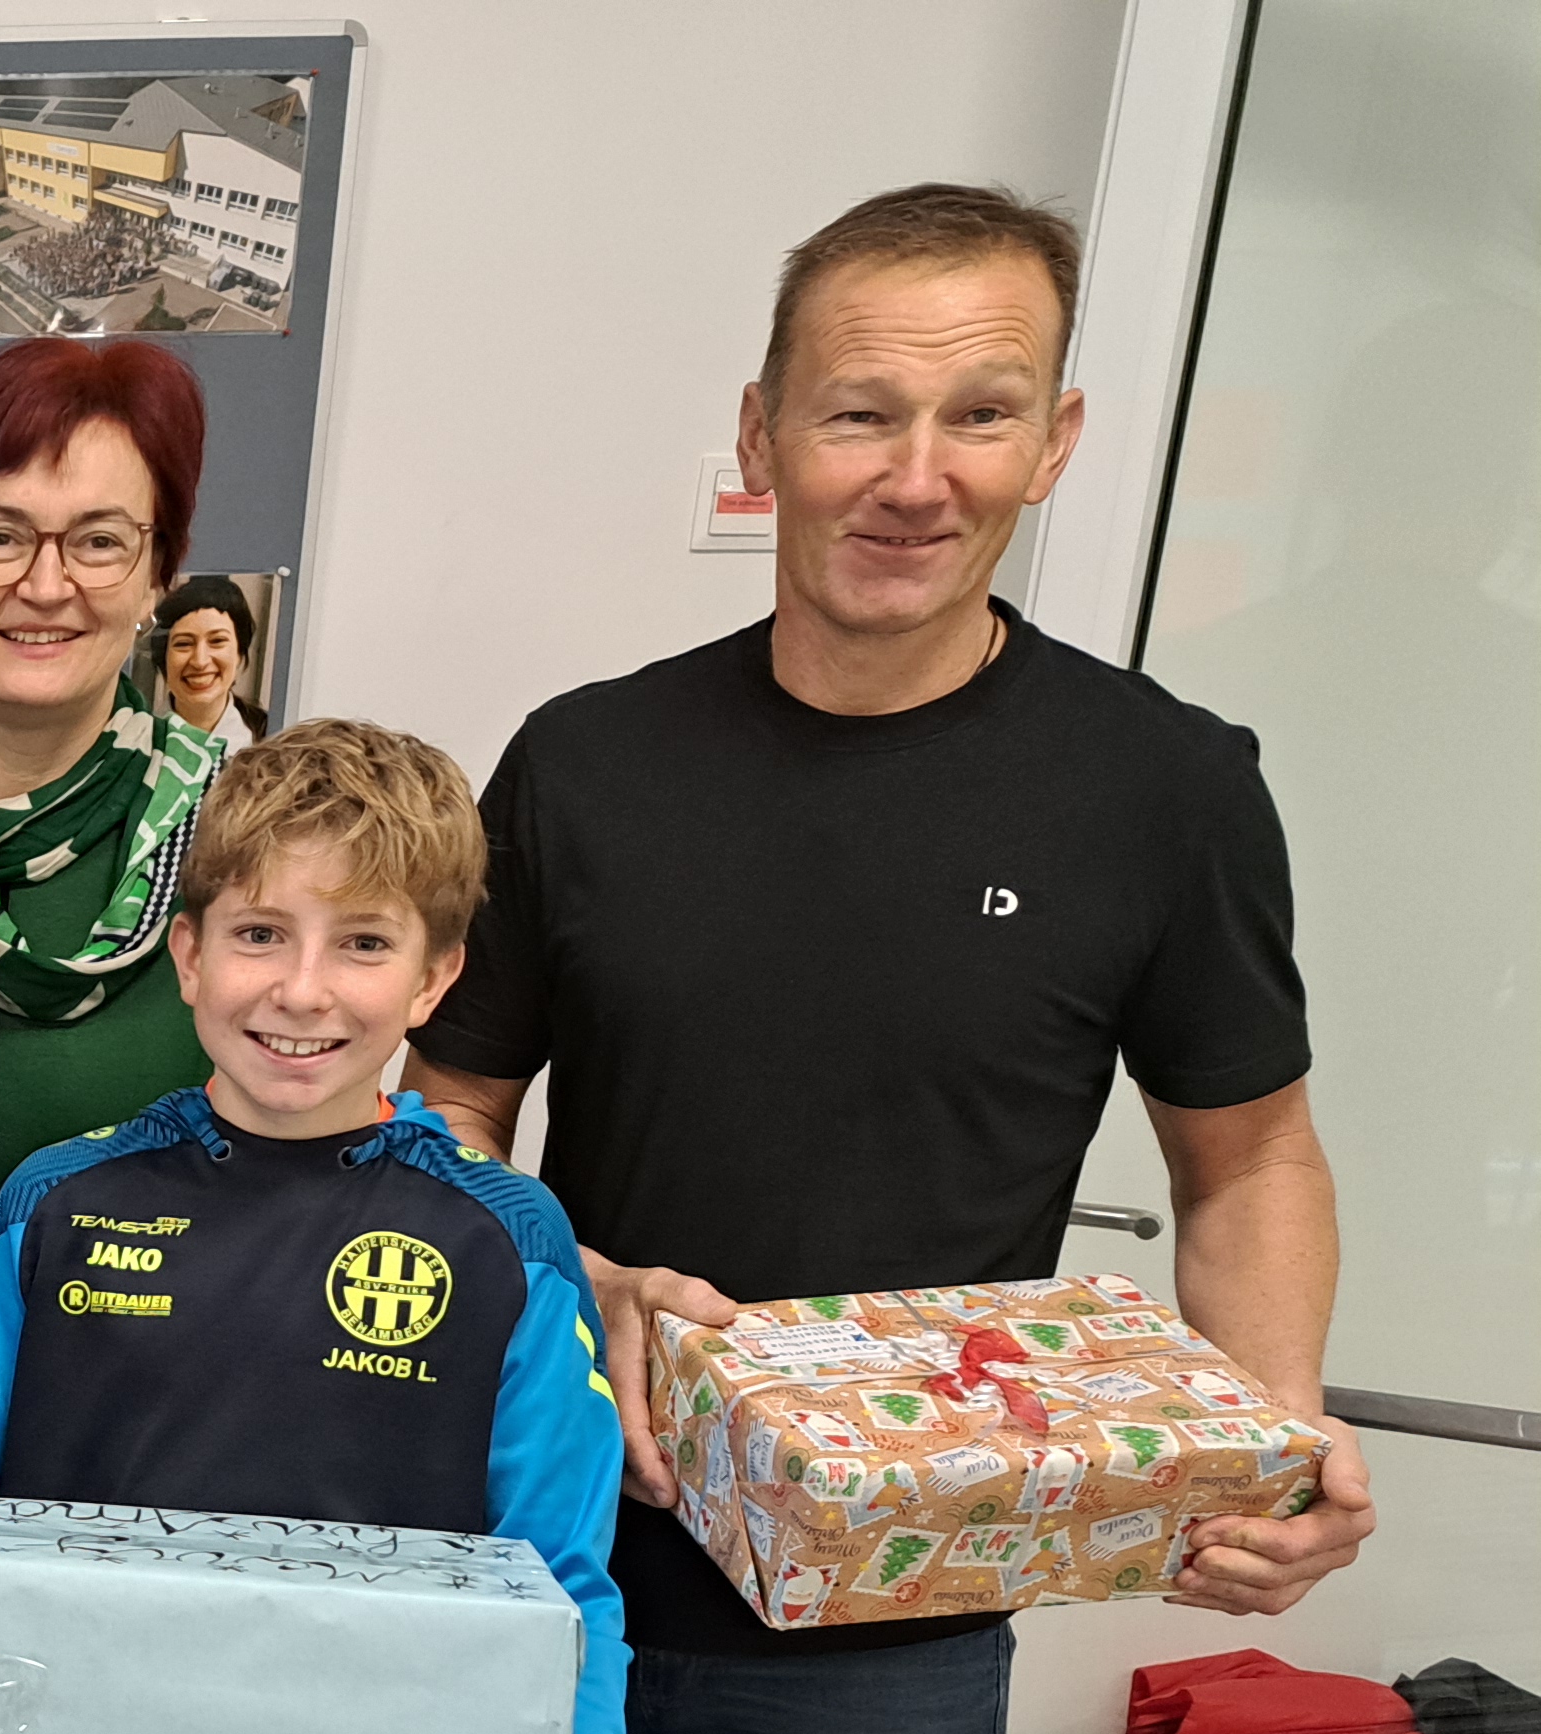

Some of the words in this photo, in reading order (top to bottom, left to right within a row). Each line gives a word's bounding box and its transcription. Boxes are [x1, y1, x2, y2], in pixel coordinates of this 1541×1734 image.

[71, 1215, 187, 1236] TEAMSPORT
[86, 1242, 163, 1272] JAKO
[337, 1236, 446, 1279] HAIDERSHOFEN
[322, 1348, 413, 1379] JAKOB
[416, 1361, 438, 1383] L.
[1185, 1421, 1265, 1444] XMAS
[761, 1432, 774, 1471] Dear
[934, 1450, 979, 1466] Santa
[963, 1456, 1000, 1479] Dear
[1189, 1474, 1253, 1490] Christmas
[1097, 1515, 1144, 1534] Santa
[1117, 1523, 1154, 1545] Dear
[813, 1543, 861, 1558] Merry
[956, 1530, 1020, 1562] XMAS
[37, 1535, 414, 1584] Merry
[933, 1590, 995, 1605] Christmas
